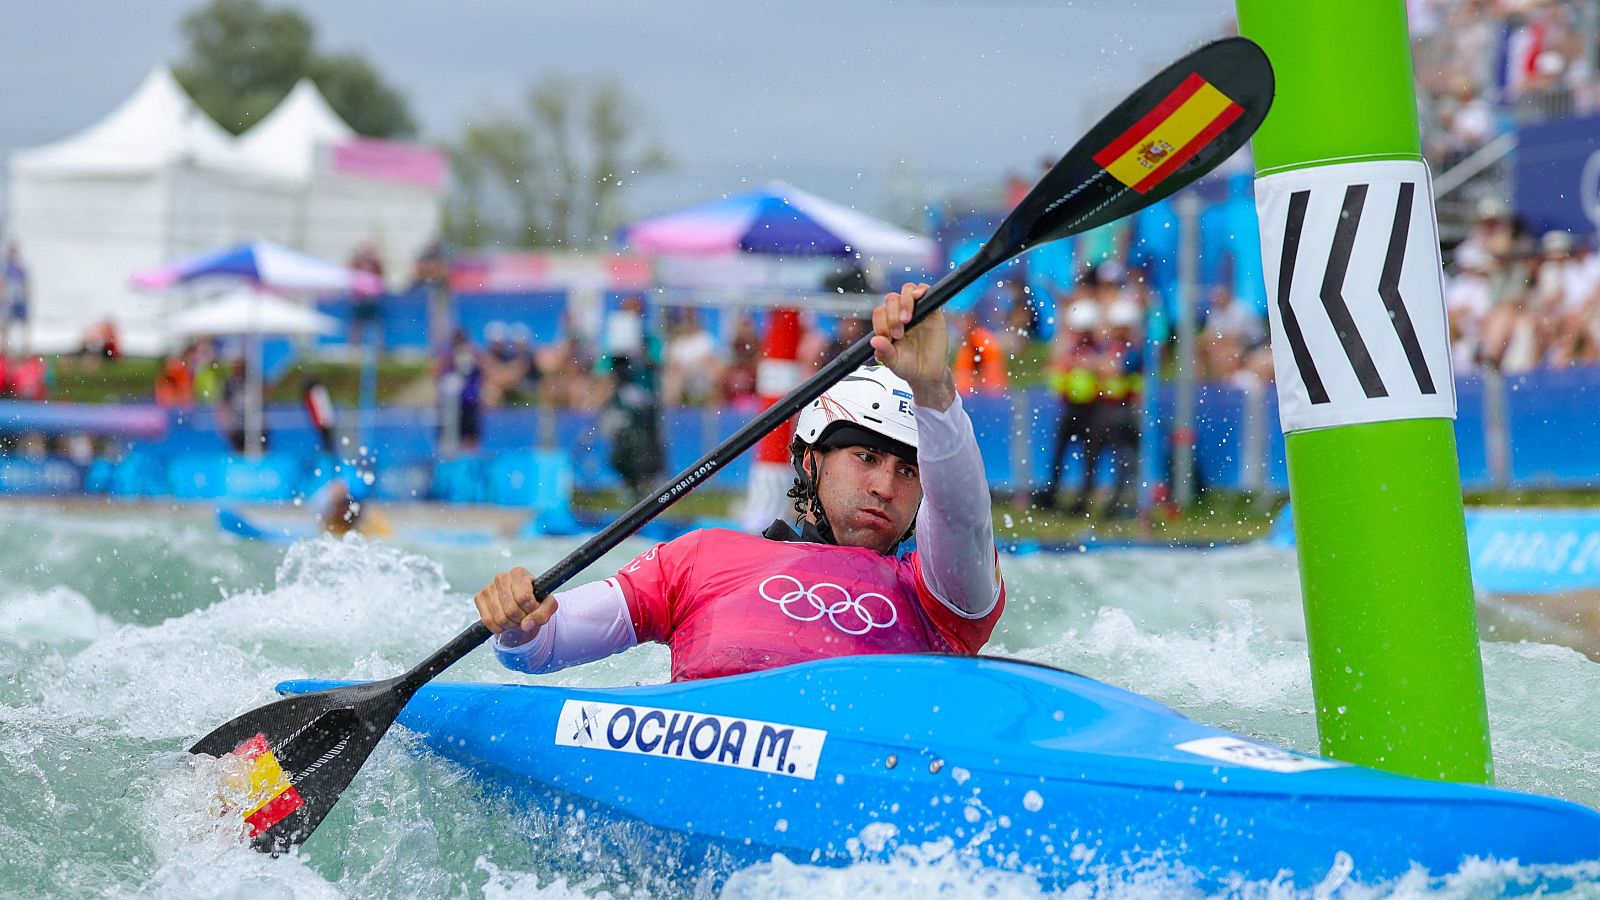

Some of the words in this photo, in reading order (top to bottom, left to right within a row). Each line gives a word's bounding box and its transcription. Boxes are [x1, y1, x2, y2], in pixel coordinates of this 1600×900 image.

[671, 475, 695, 495] PARIS
[694, 460, 717, 478] 2024
[606, 707, 747, 764] OCHOA
[752, 724, 796, 774] M.
